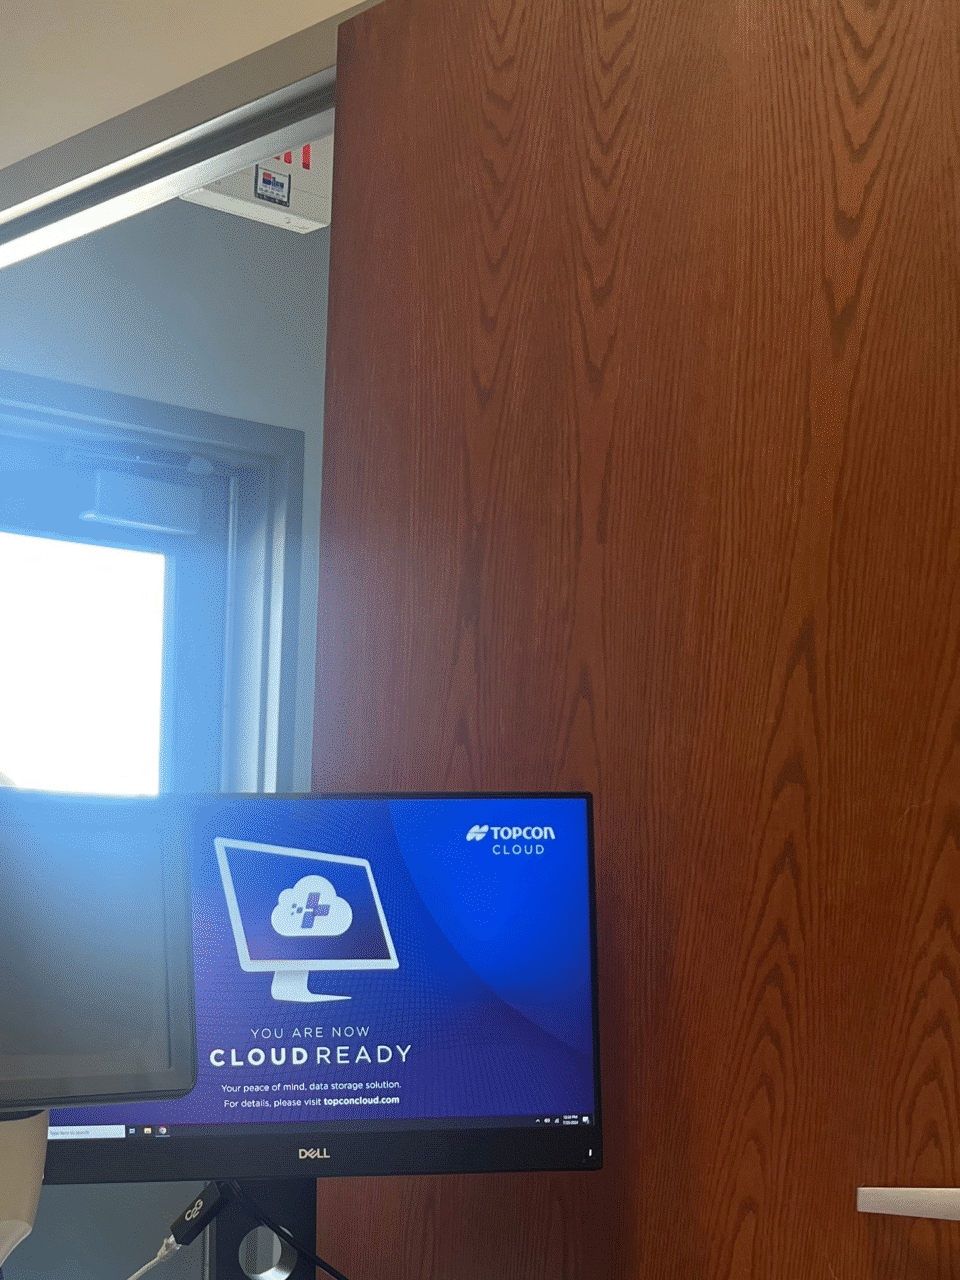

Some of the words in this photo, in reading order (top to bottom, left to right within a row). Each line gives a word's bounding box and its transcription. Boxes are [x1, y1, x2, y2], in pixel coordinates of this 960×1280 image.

[490, 826, 556, 840] TOPCON
[492, 844, 545, 855] CLOUD
[250, 1028, 284, 1039] YOU
[291, 1027, 324, 1038] ARE
[331, 1026, 370, 1038] NOW
[221, 1084, 241, 1093] Your
[243, 1084, 270, 1093] peace
[271, 1083, 281, 1091] of
[309, 1082, 329, 1091] data
[331, 1081, 364, 1091] storage
[365, 1080, 402, 1090] solution.
[223, 1100, 239, 1108] For
[273, 1098, 302, 1108] please
[304, 1098, 322, 1107] visit
[323, 1096, 400, 1107] topconcloud.com
[298, 1147, 331, 1160] DELL
[184, 1199, 204, 1222] C2G
